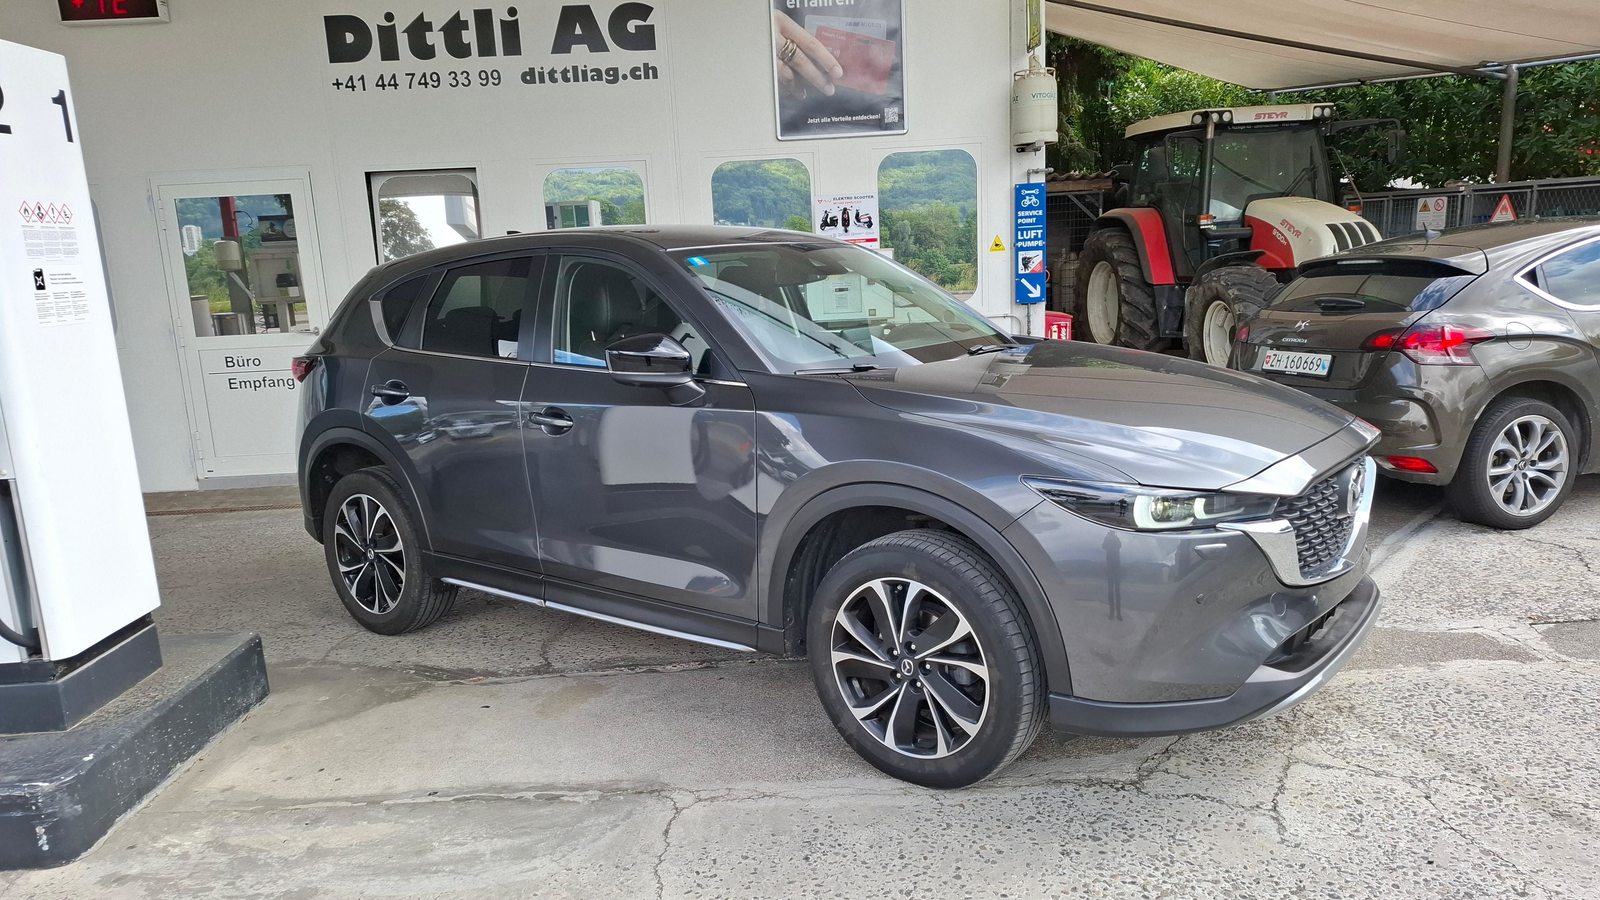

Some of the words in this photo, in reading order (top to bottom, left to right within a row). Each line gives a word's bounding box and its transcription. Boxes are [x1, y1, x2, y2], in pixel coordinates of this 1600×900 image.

[323, 6, 522, 64] Dittli
[550, 2, 657, 54] AG
[332, 74, 367, 92] +41
[375, 73, 399, 91] 44
[405, 71, 441, 89] 749
[448, 70, 472, 88] 33
[478, 69, 502, 87] 99
[520, 63, 659, 85] dittliag.ch
[51, 89, 74, 143] 1
[1254, 111, 1289, 120] STEYR
[1018, 209, 1043, 217] SERVICE
[1018, 230, 1043, 240] LUFT
[1280, 218, 1302, 239] STEYR
[224, 356, 262, 368] Büro
[228, 376, 296, 391] Empfang
